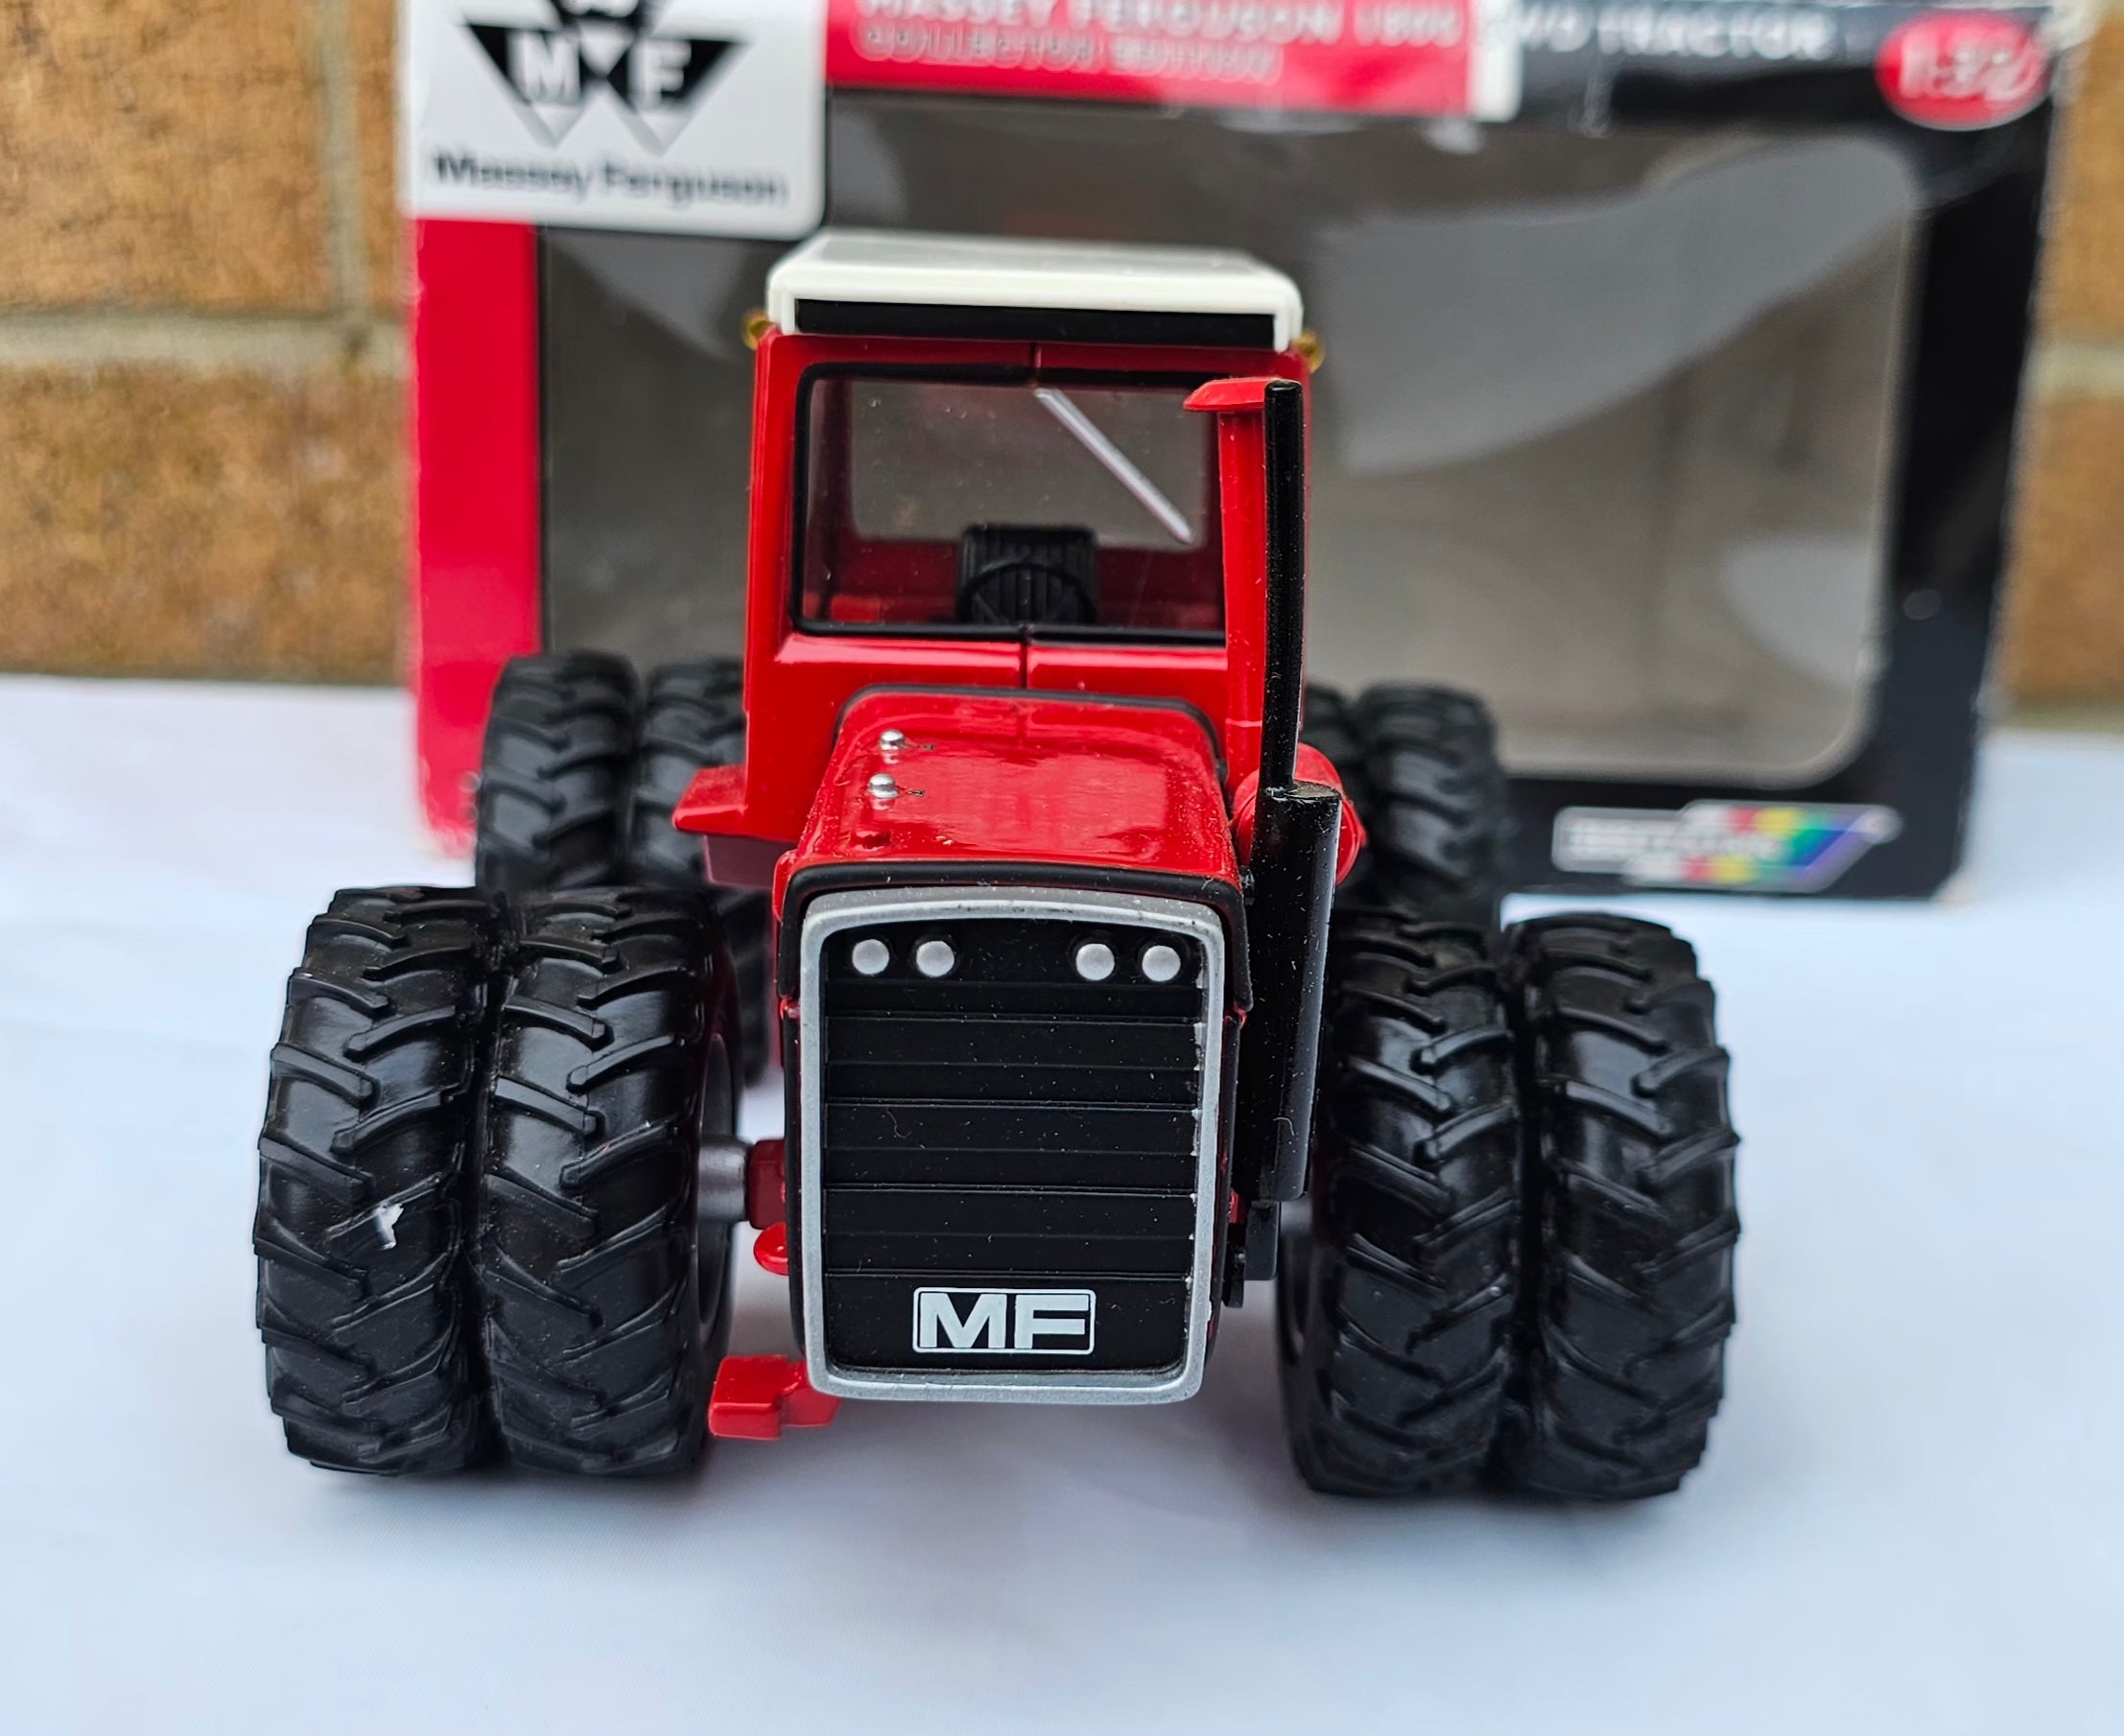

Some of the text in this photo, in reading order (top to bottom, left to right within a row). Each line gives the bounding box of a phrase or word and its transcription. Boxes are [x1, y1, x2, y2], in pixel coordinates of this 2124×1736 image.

[1598, 5, 1836, 59] TRACTOR
[434, 152, 789, 204] Massey Ferguson
[918, 1292, 1090, 1349] MF
